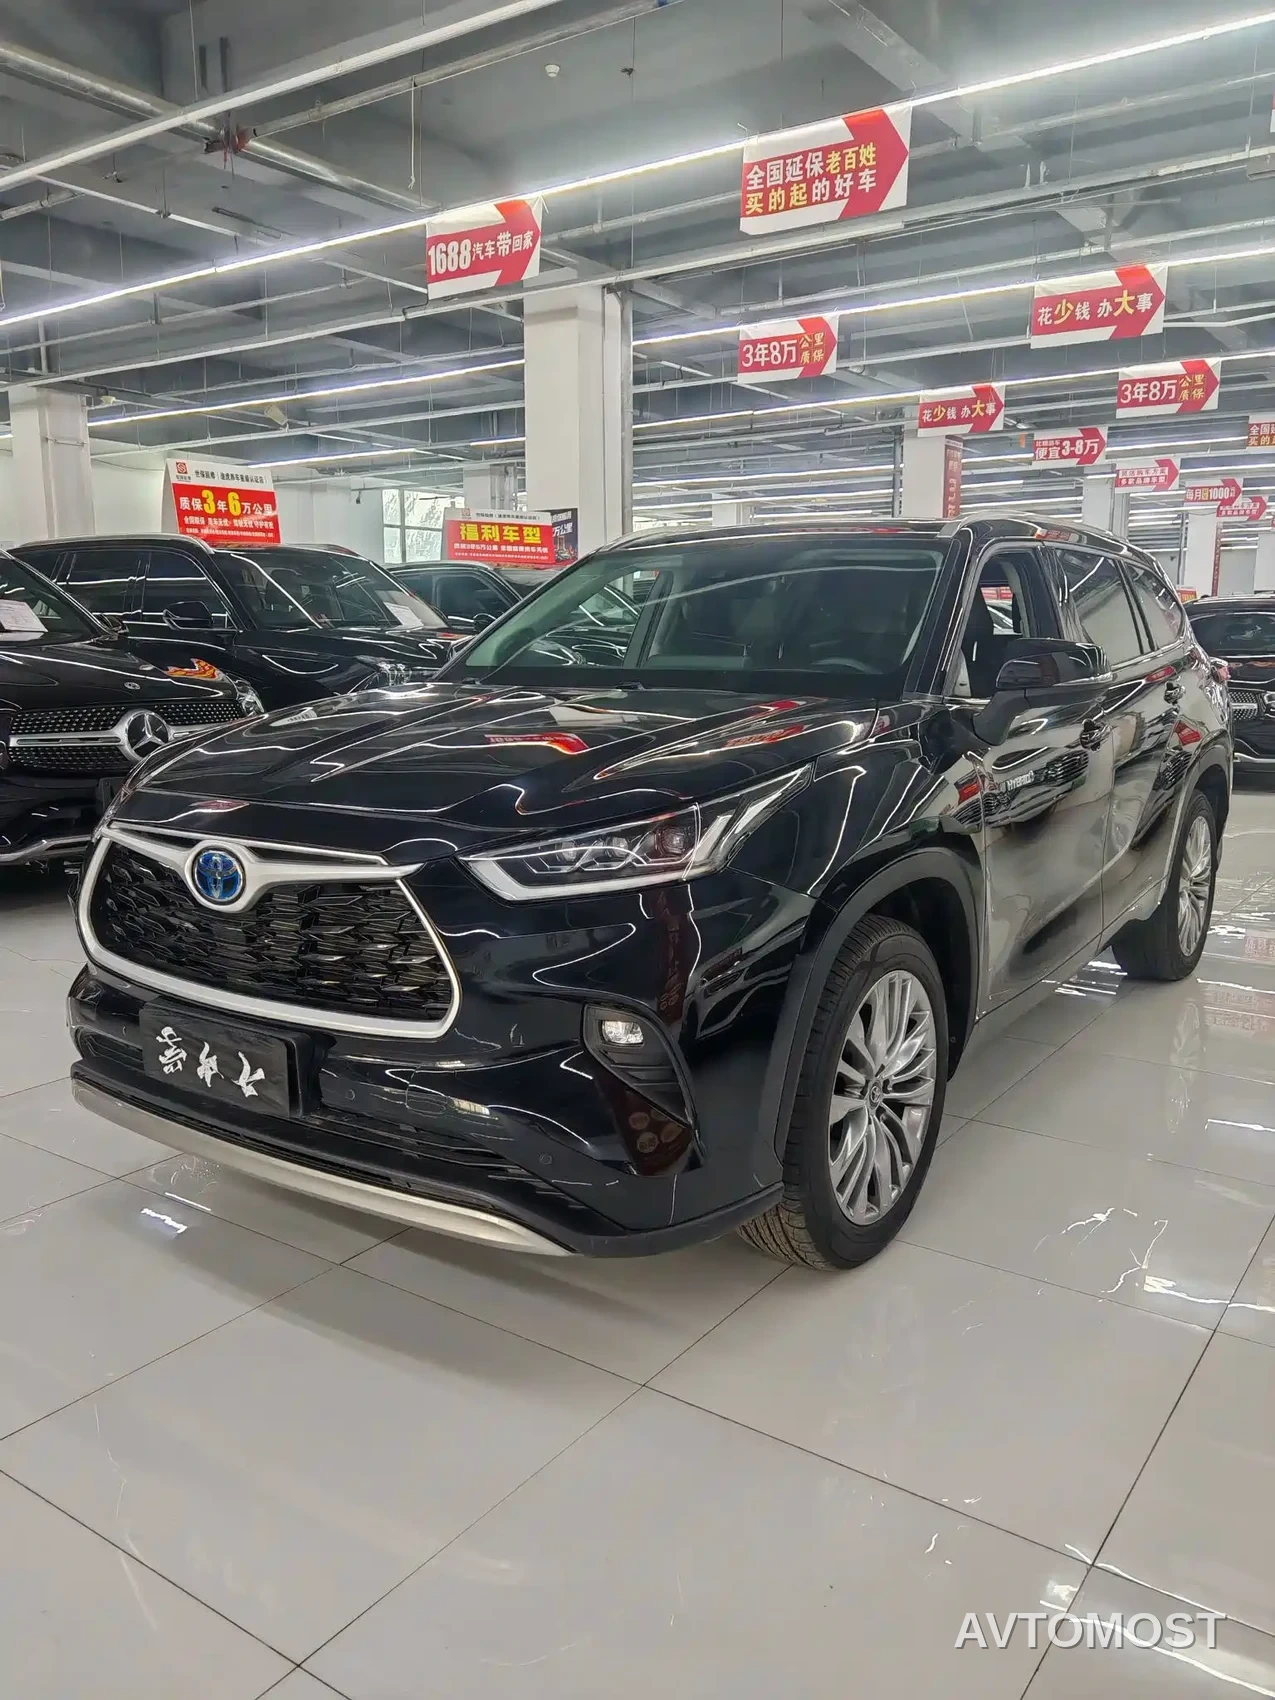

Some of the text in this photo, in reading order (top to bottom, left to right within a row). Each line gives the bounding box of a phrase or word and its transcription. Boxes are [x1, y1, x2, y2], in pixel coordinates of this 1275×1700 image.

[746, 142, 877, 190] 全国延保老百姓
[745, 168, 877, 215] 买的起的好车
[1037, 289, 1153, 327] 花少钱 办大事
[922, 399, 997, 423] 花少钱 办大事
[179, 489, 273, 516] 质保3年6万公里
[459, 523, 542, 544] 福利车型
